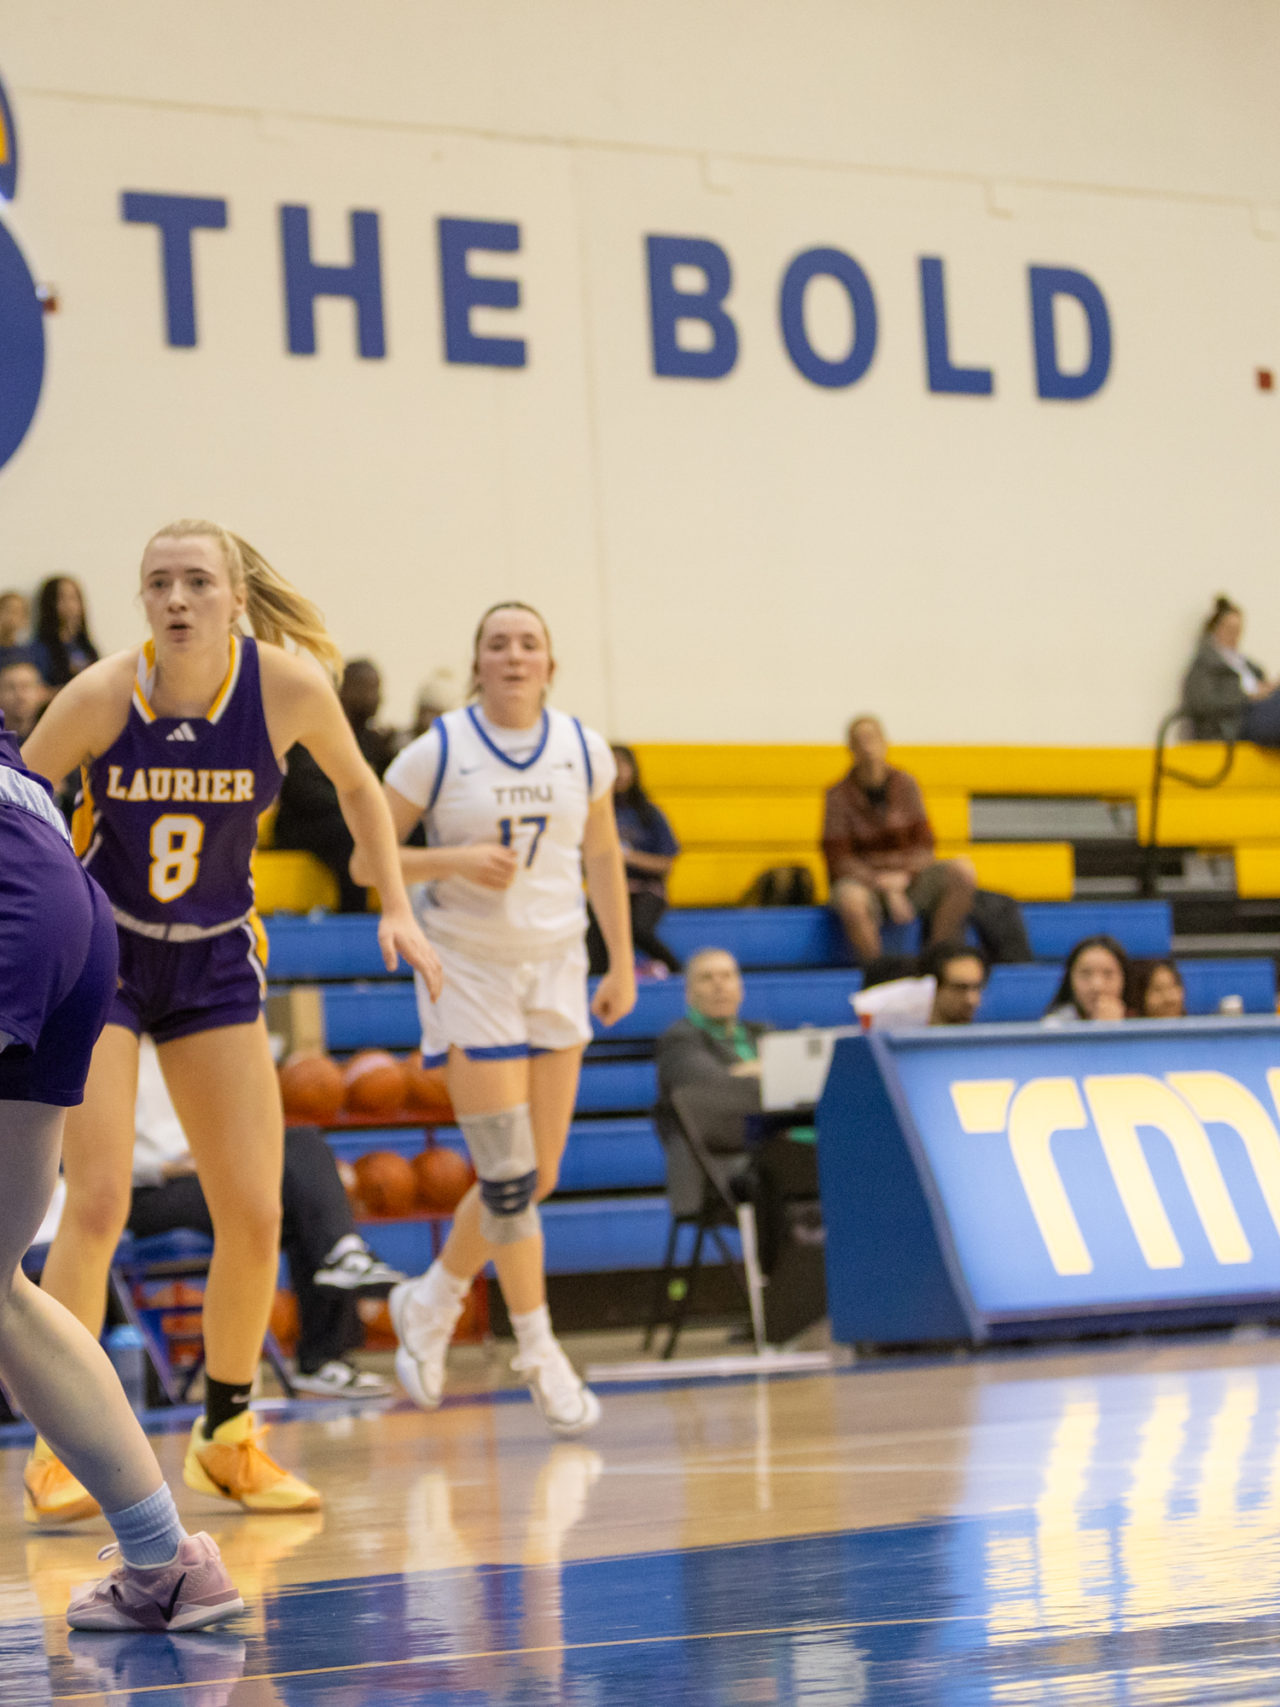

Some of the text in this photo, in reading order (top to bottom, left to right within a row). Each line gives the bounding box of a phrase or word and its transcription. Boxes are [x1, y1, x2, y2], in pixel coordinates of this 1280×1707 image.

[121, 191, 527, 368] THE
[646, 235, 1113, 402] BOLD
[106, 765, 255, 803] LAURIER
[493, 784, 554, 805] TMU
[148, 813, 206, 904] 8
[498, 815, 550, 870] 17
[949, 1066, 1280, 1276] TM
